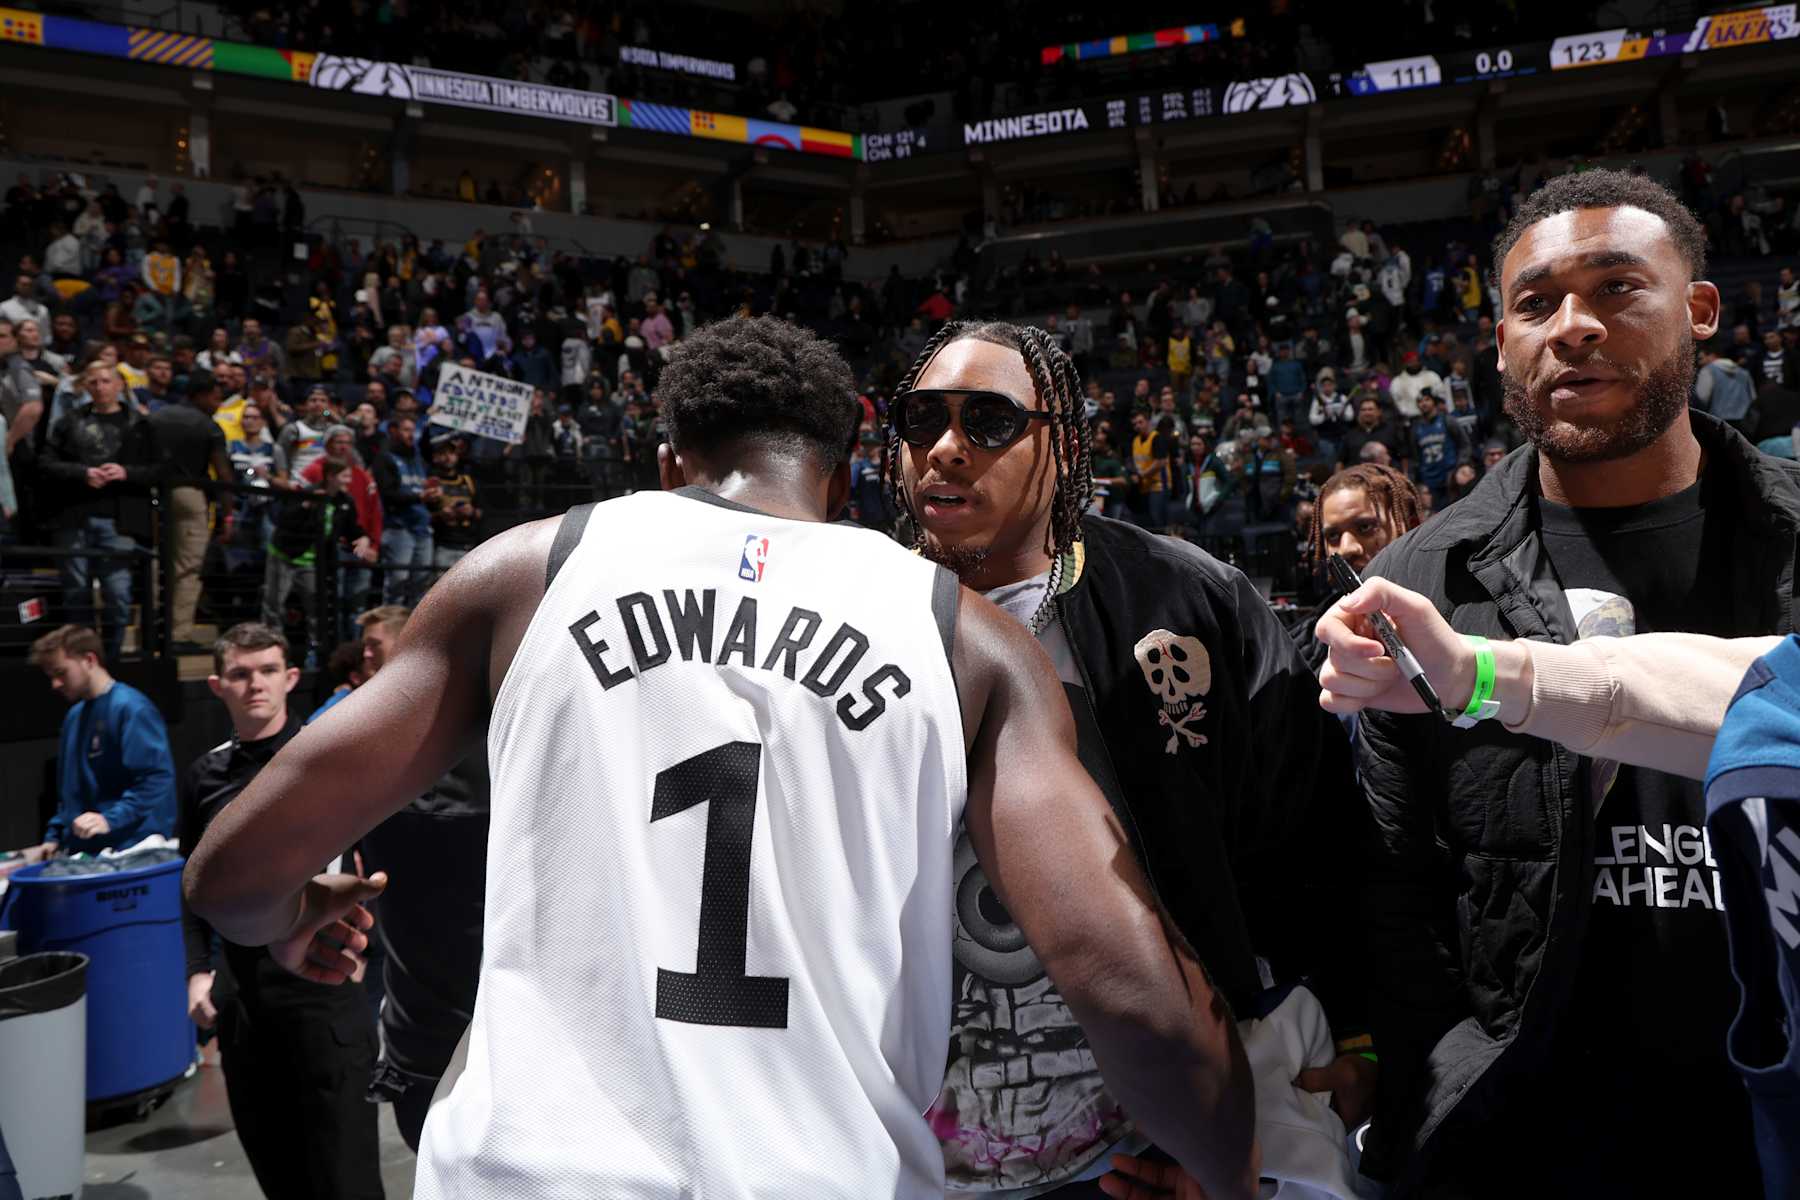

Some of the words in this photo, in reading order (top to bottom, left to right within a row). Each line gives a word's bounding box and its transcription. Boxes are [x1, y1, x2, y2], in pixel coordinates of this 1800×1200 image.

[1475, 49, 1513, 74] 0.0
[1563, 42, 1605, 63] 123
[1393, 66, 1427, 86] 111
[490, 81, 609, 120] TIMBERWOLVES
[963, 107, 1089, 144] MINNESOTA
[568, 588, 912, 732] EDWARDS
[96, 884, 150, 902] BRUTE
[649, 740, 790, 1029] 1
